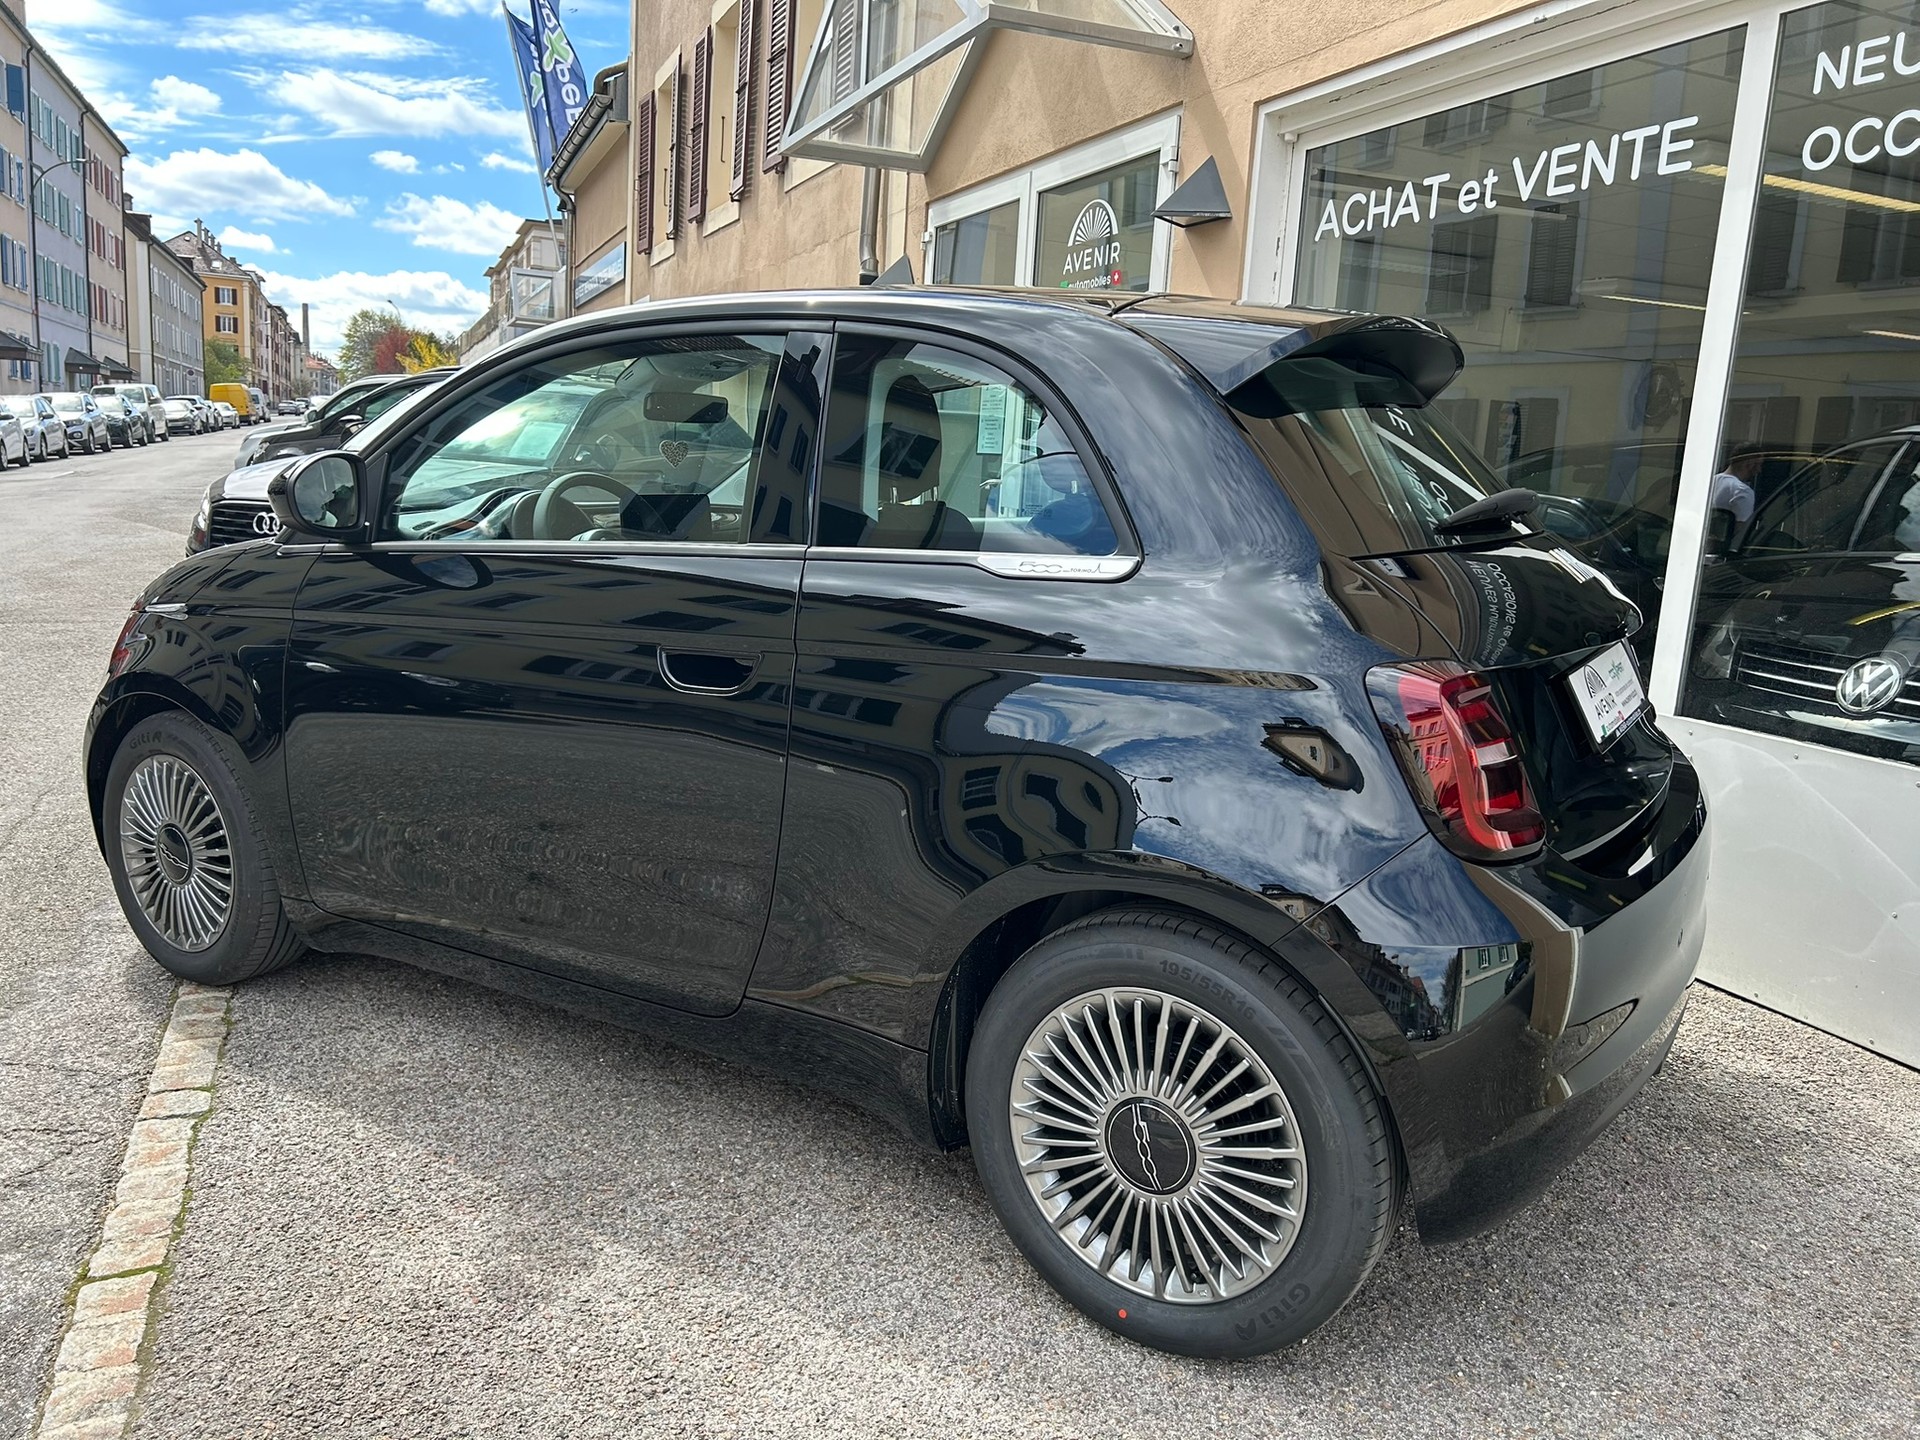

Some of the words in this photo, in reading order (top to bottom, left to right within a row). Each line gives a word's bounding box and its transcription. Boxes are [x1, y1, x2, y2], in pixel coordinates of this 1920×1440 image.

[1314, 172, 1451, 242] ACHAT
[1458, 168, 1499, 214] et
[1512, 115, 1699, 202] VENTE
[1062, 242, 1121, 275] AVENIR
[1018, 561, 1063, 573] 500
